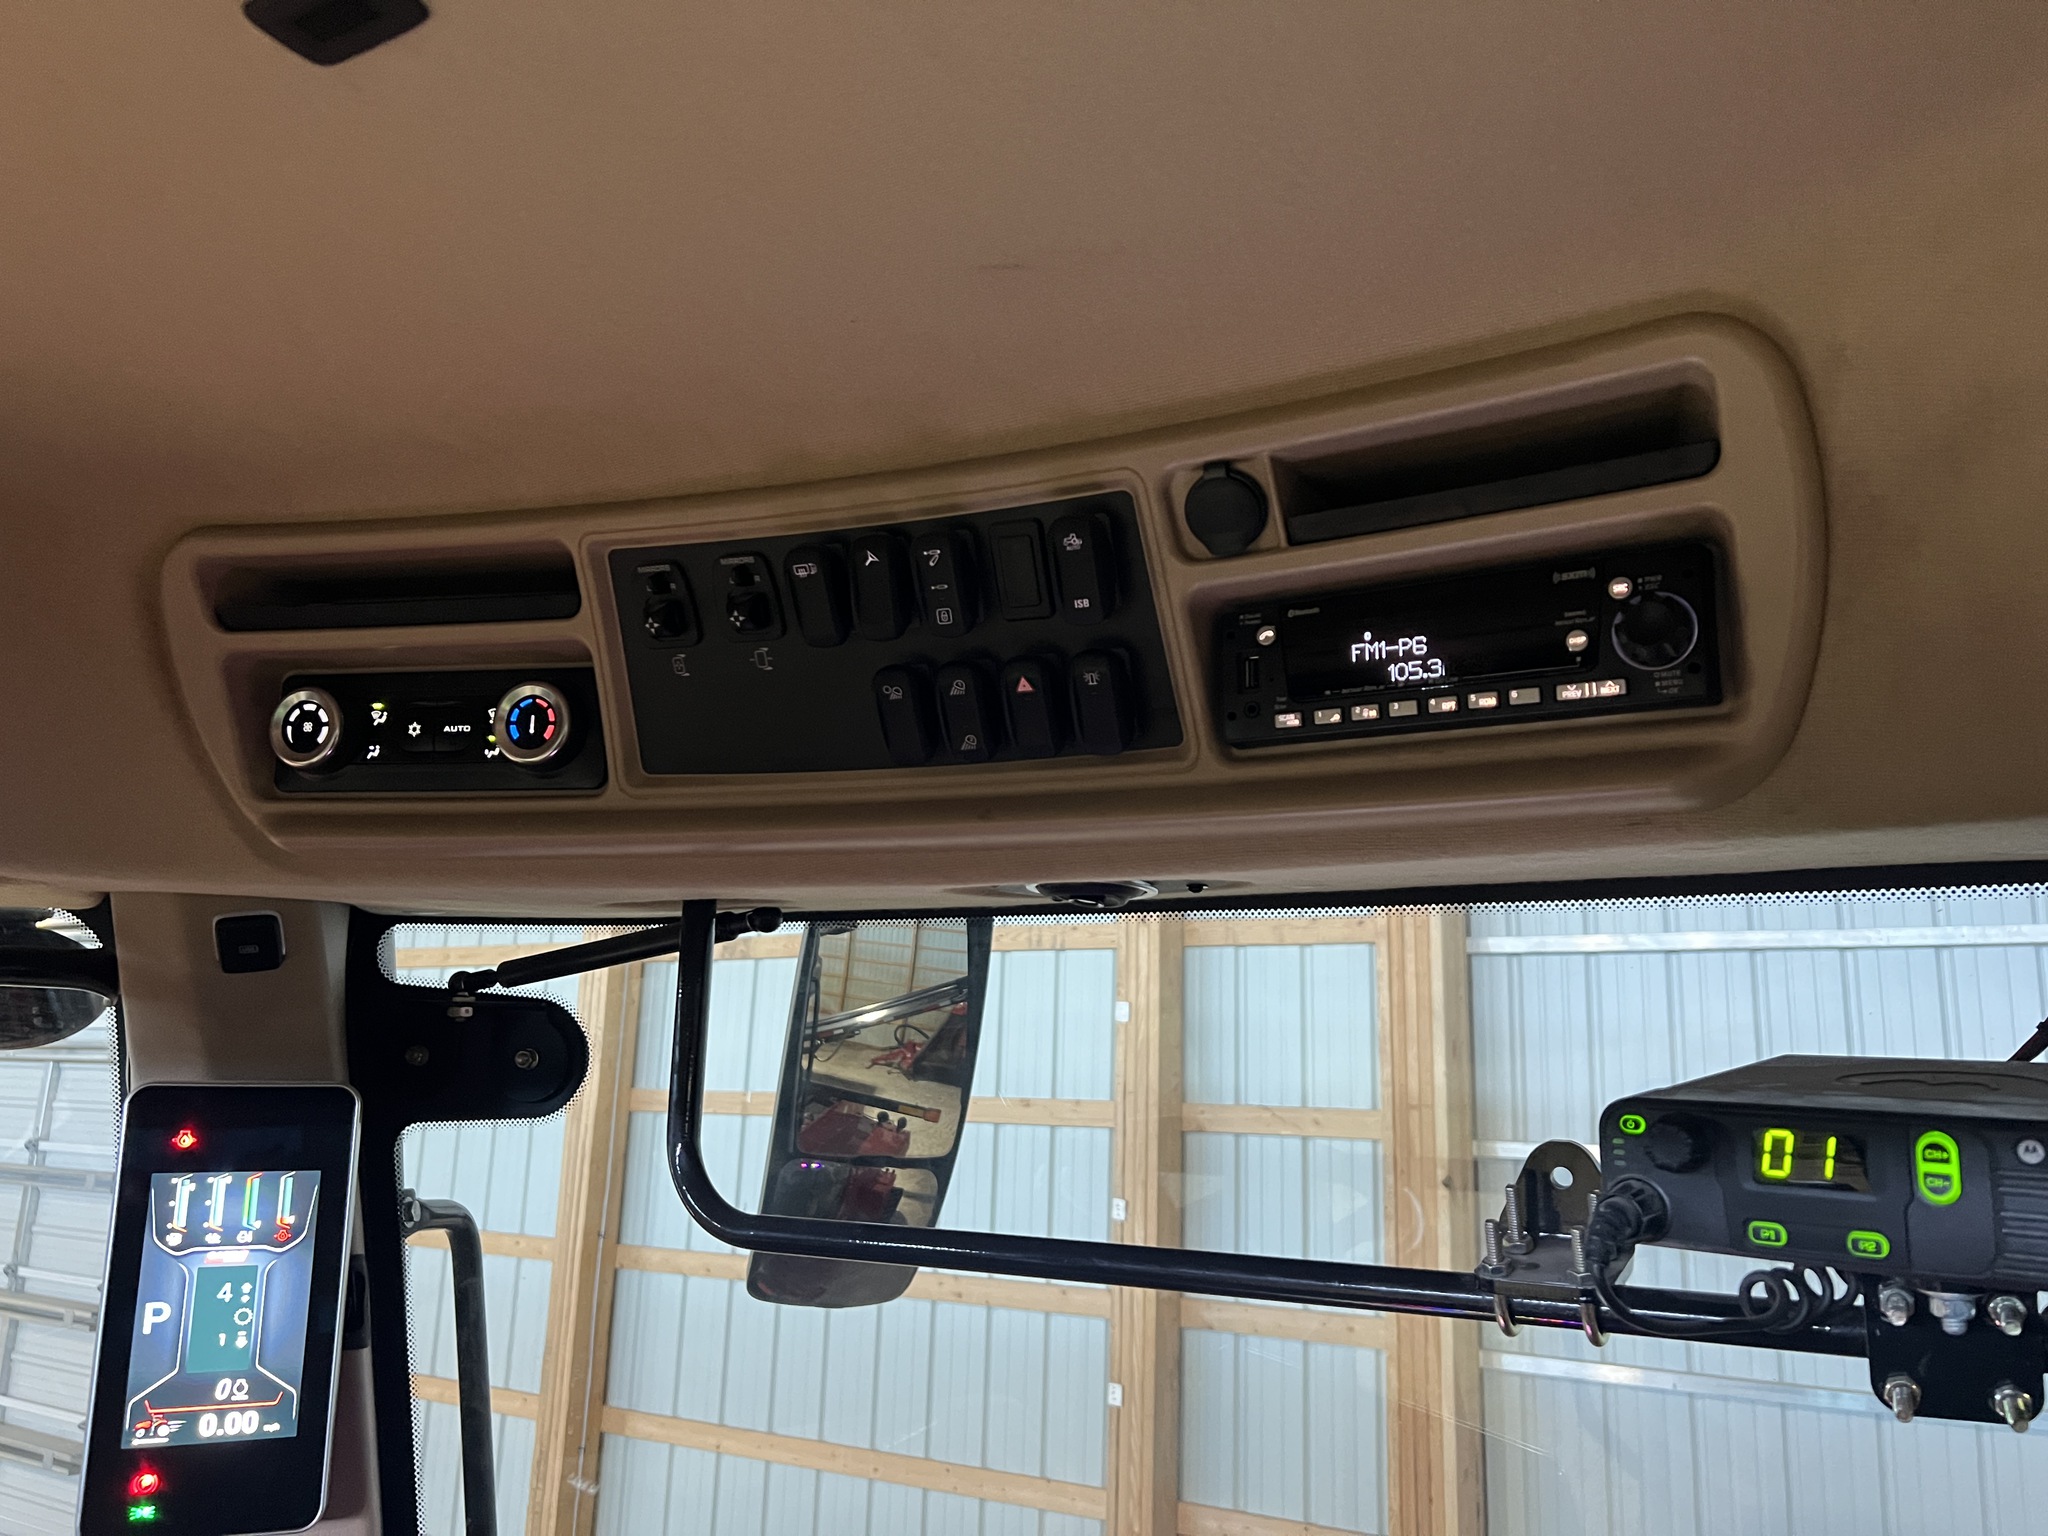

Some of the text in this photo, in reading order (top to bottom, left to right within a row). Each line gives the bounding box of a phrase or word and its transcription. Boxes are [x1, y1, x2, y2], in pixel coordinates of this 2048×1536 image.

[720, 556, 755, 565] MIRRORS
[637, 564, 671, 574] MIRRORS
[1074, 598, 1089, 608] ISB
[1351, 635, 1428, 663] FM1-P6
[1561, 689, 1582, 698] PREV
[1600, 685, 1620, 695] NEXT
[443, 724, 471, 733] AUTO
[1761, 1128, 1837, 1180] 01
[1924, 1149, 1949, 1160] CH+
[1925, 1176, 1951, 1187] CH-
[216, 1282, 233, 1302] 4
[142, 1302, 172, 1335] P
[218, 1333, 226, 1346] 1
[214, 1378, 232, 1401] 0
[198, 1410, 260, 1438] 0.00
